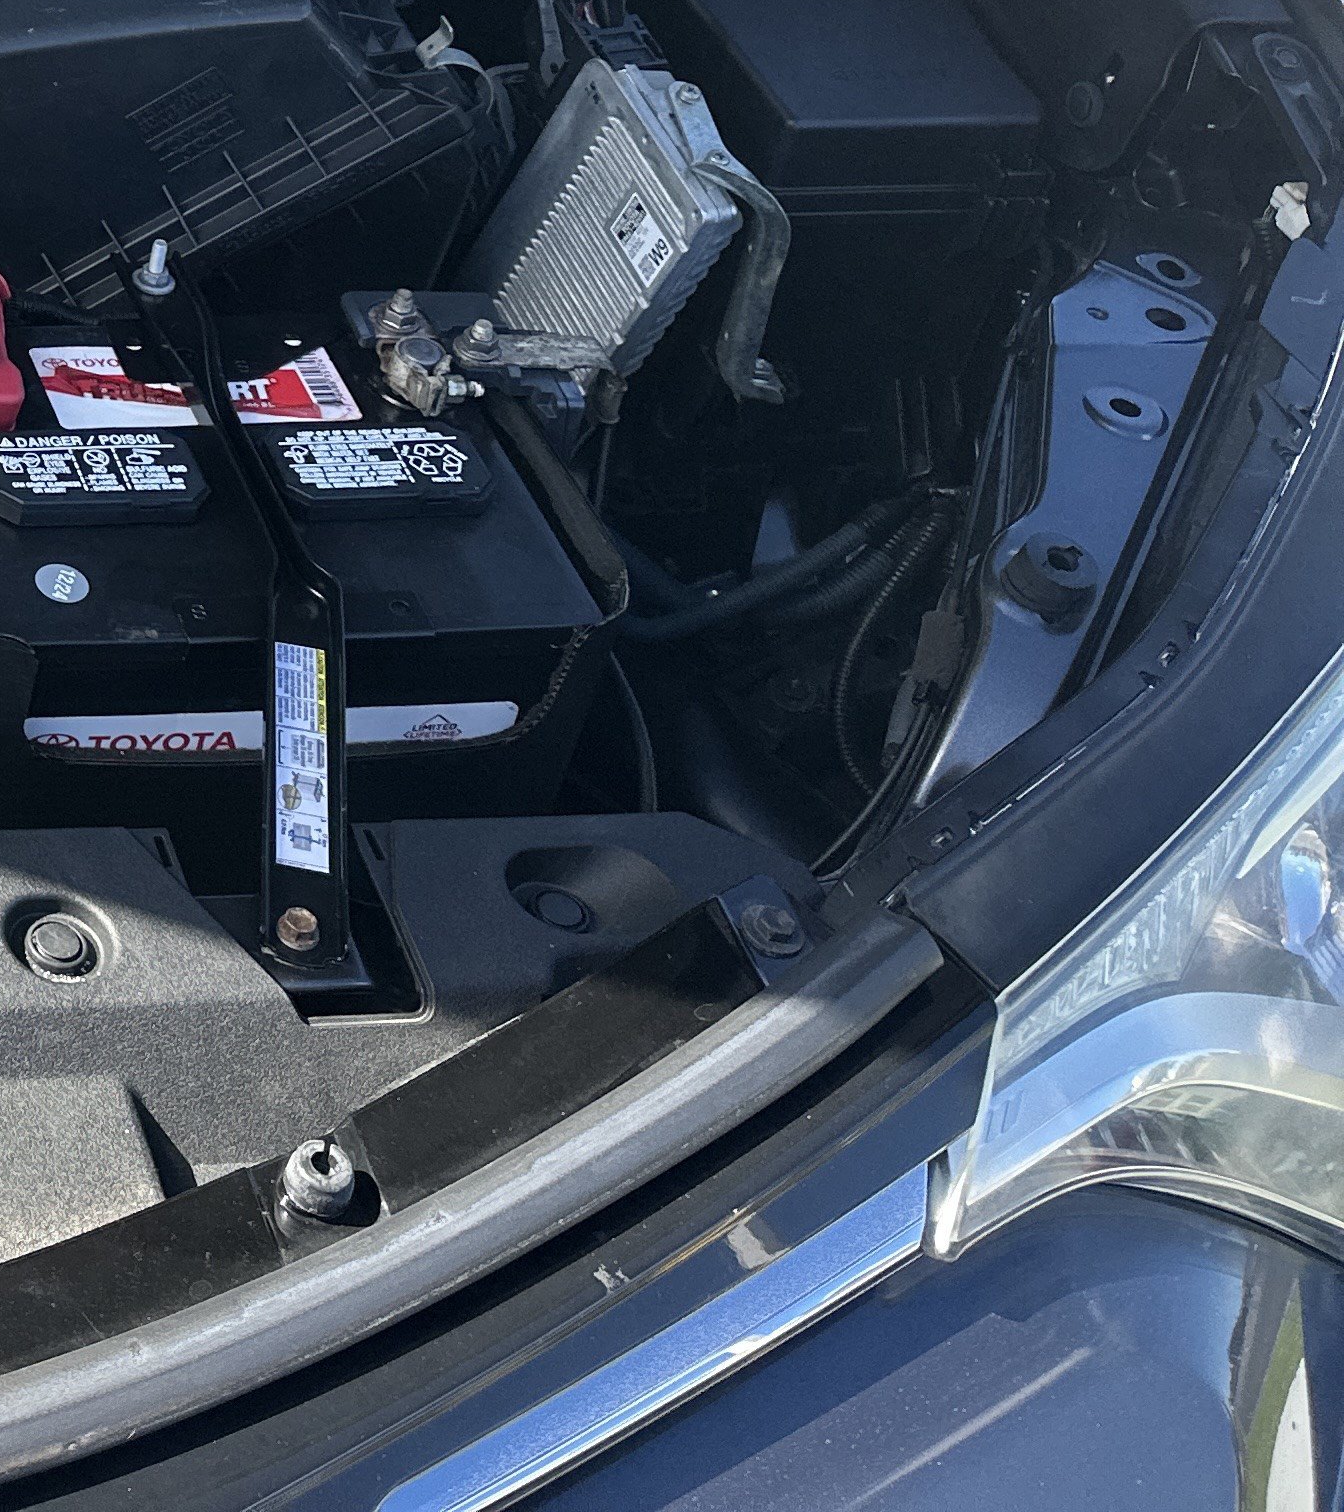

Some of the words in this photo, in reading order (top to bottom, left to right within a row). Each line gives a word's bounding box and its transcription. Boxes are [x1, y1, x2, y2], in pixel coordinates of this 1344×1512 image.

[648, 237, 669, 267] W9
[14, 435, 84, 448] DANGER
[86, 435, 95, 446] /
[98, 433, 161, 446] POISON
[88, 731, 237, 751] TOYOTA
